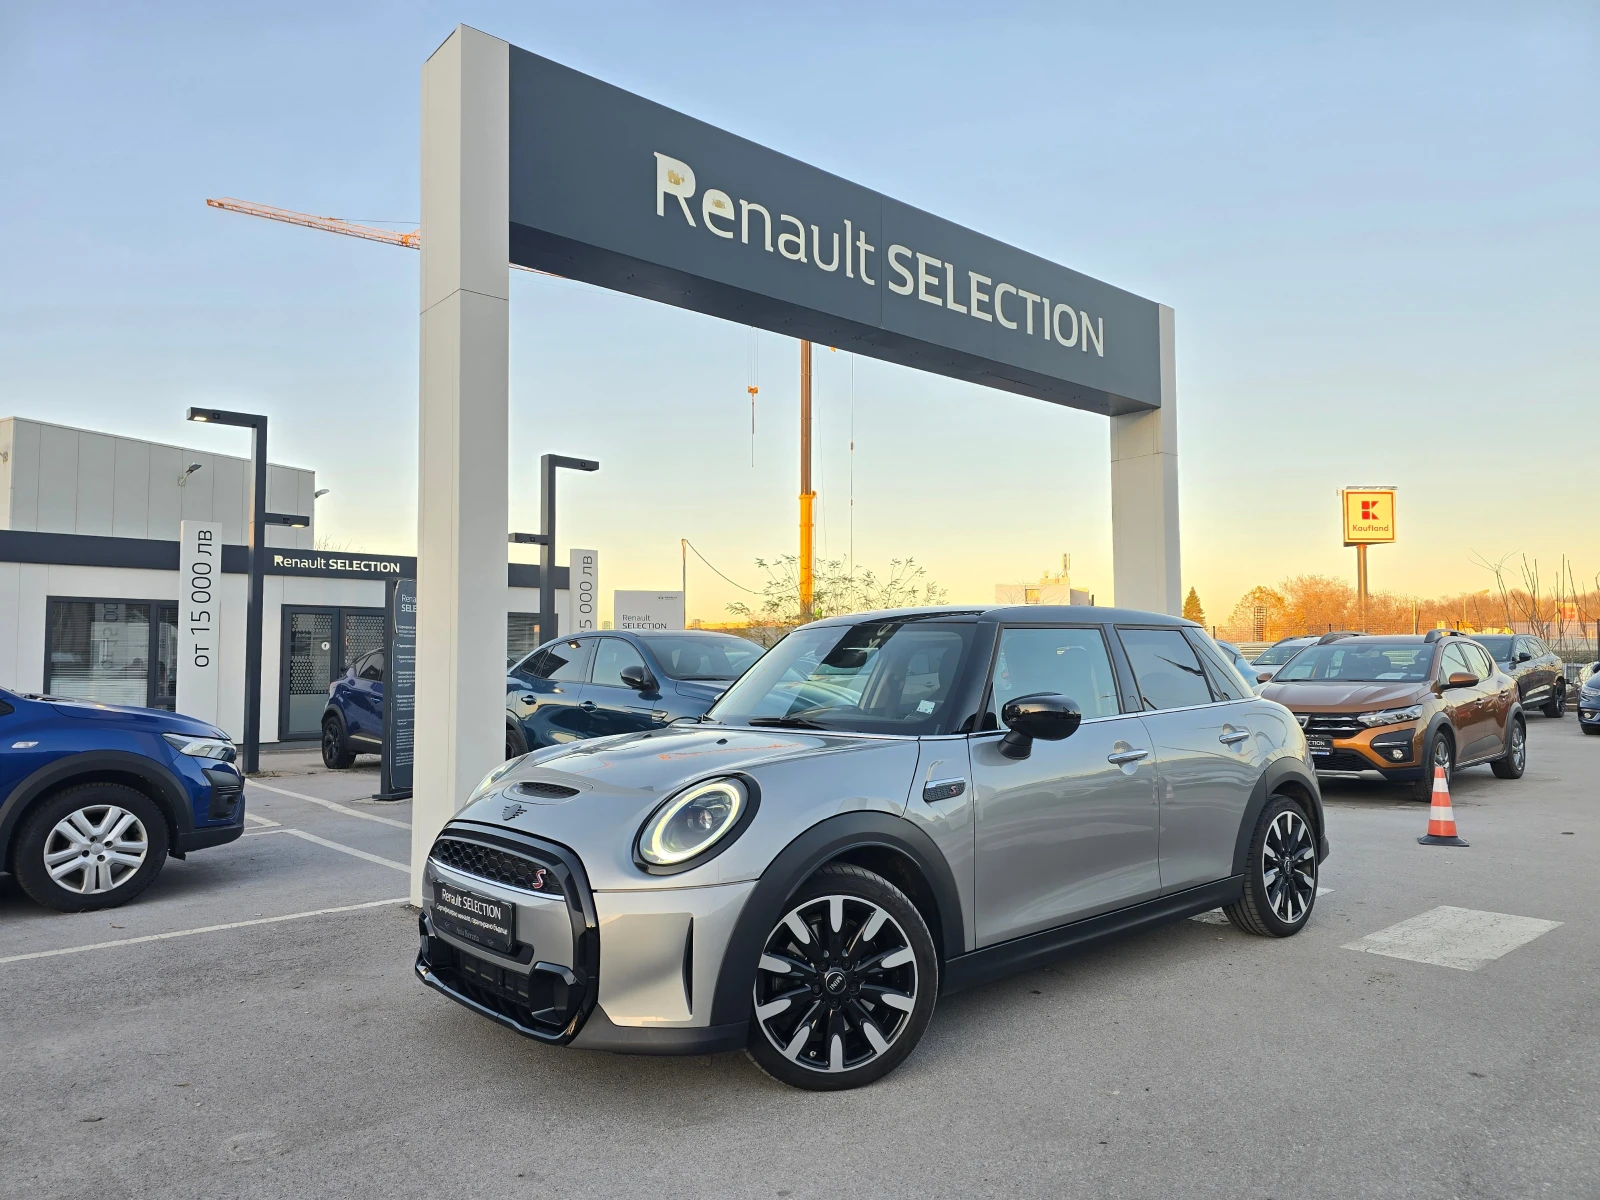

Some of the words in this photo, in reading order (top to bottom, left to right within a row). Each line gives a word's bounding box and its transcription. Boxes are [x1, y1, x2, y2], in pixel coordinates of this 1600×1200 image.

[653, 151, 876, 286] Renault
[887, 243, 1104, 358] SELECTION
[1352, 524, 1389, 532] Kaufland
[273, 555, 327, 570] Renault
[328, 559, 400, 573] SELECTION
[191, 562, 212, 604] 000
[401, 594, 416, 604] Rena
[579, 581, 593, 614] 000
[190, 610, 211, 636] 15
[579, 619, 593, 632] 5
[622, 614, 651, 622] Renault
[622, 622, 667, 630] SELECTION
[532, 868, 547, 889] S
[441, 888, 462, 908] Renault
[462, 896, 502, 920] SELECTION
[829, 975, 843, 990] MINI
